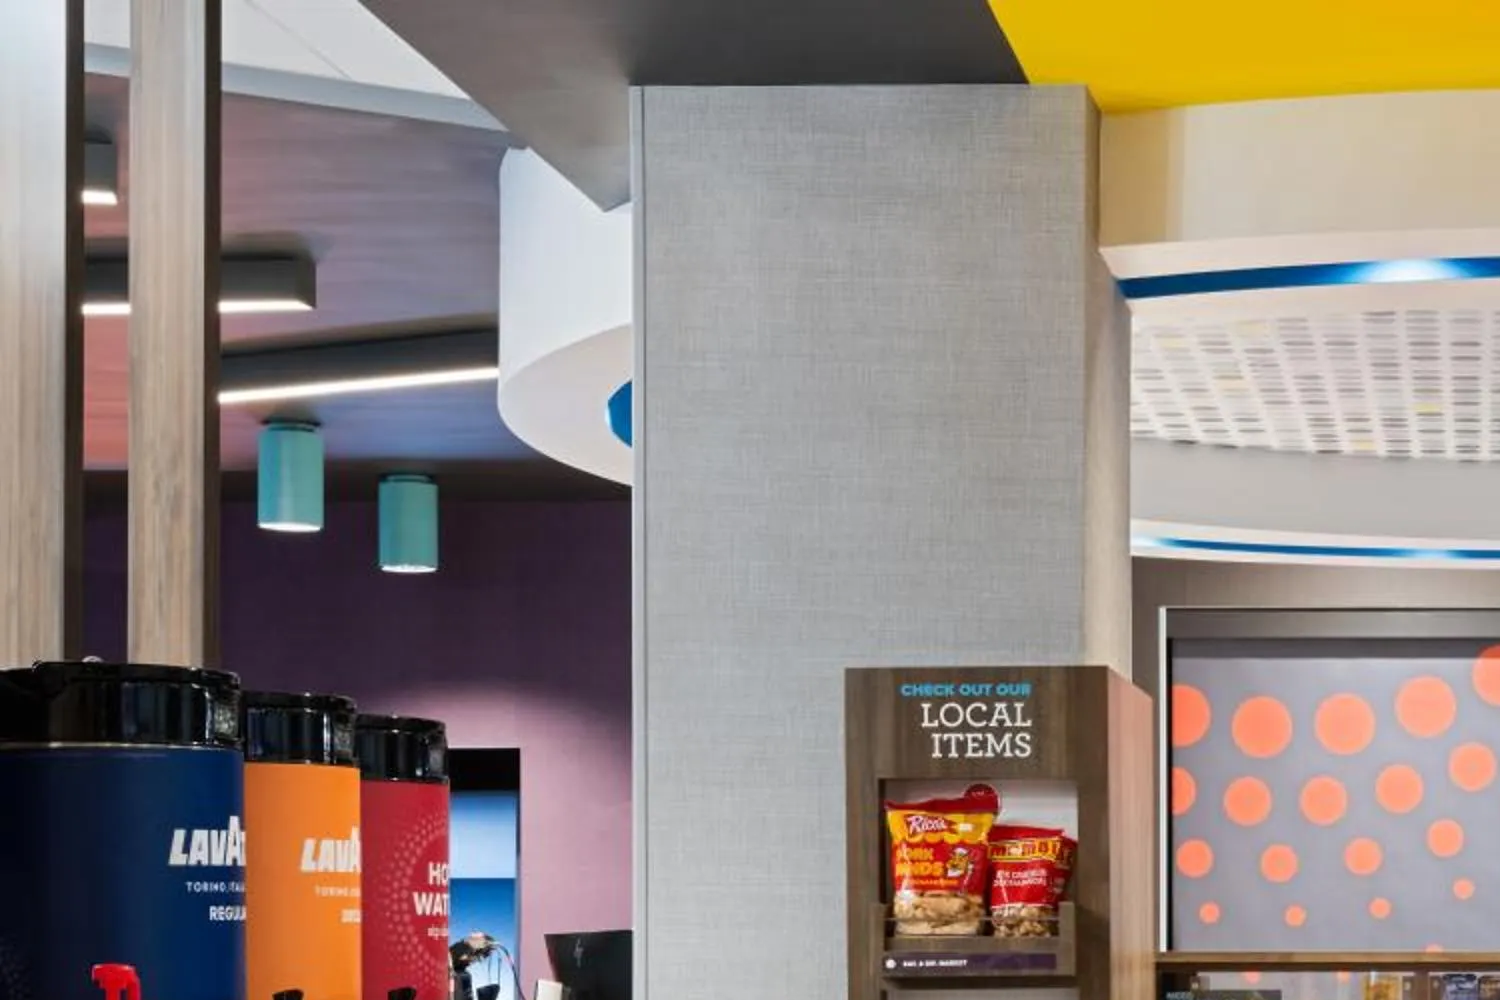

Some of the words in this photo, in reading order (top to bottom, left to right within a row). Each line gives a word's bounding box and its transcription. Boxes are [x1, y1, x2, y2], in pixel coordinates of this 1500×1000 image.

[900, 682, 955, 697] CHECK
[959, 682, 993, 697] OUT
[996, 682, 1032, 697] OUR
[921, 702, 1033, 728] LOCAL
[931, 733, 1033, 759] ITEMS
[168, 815, 246, 867] LAVA
